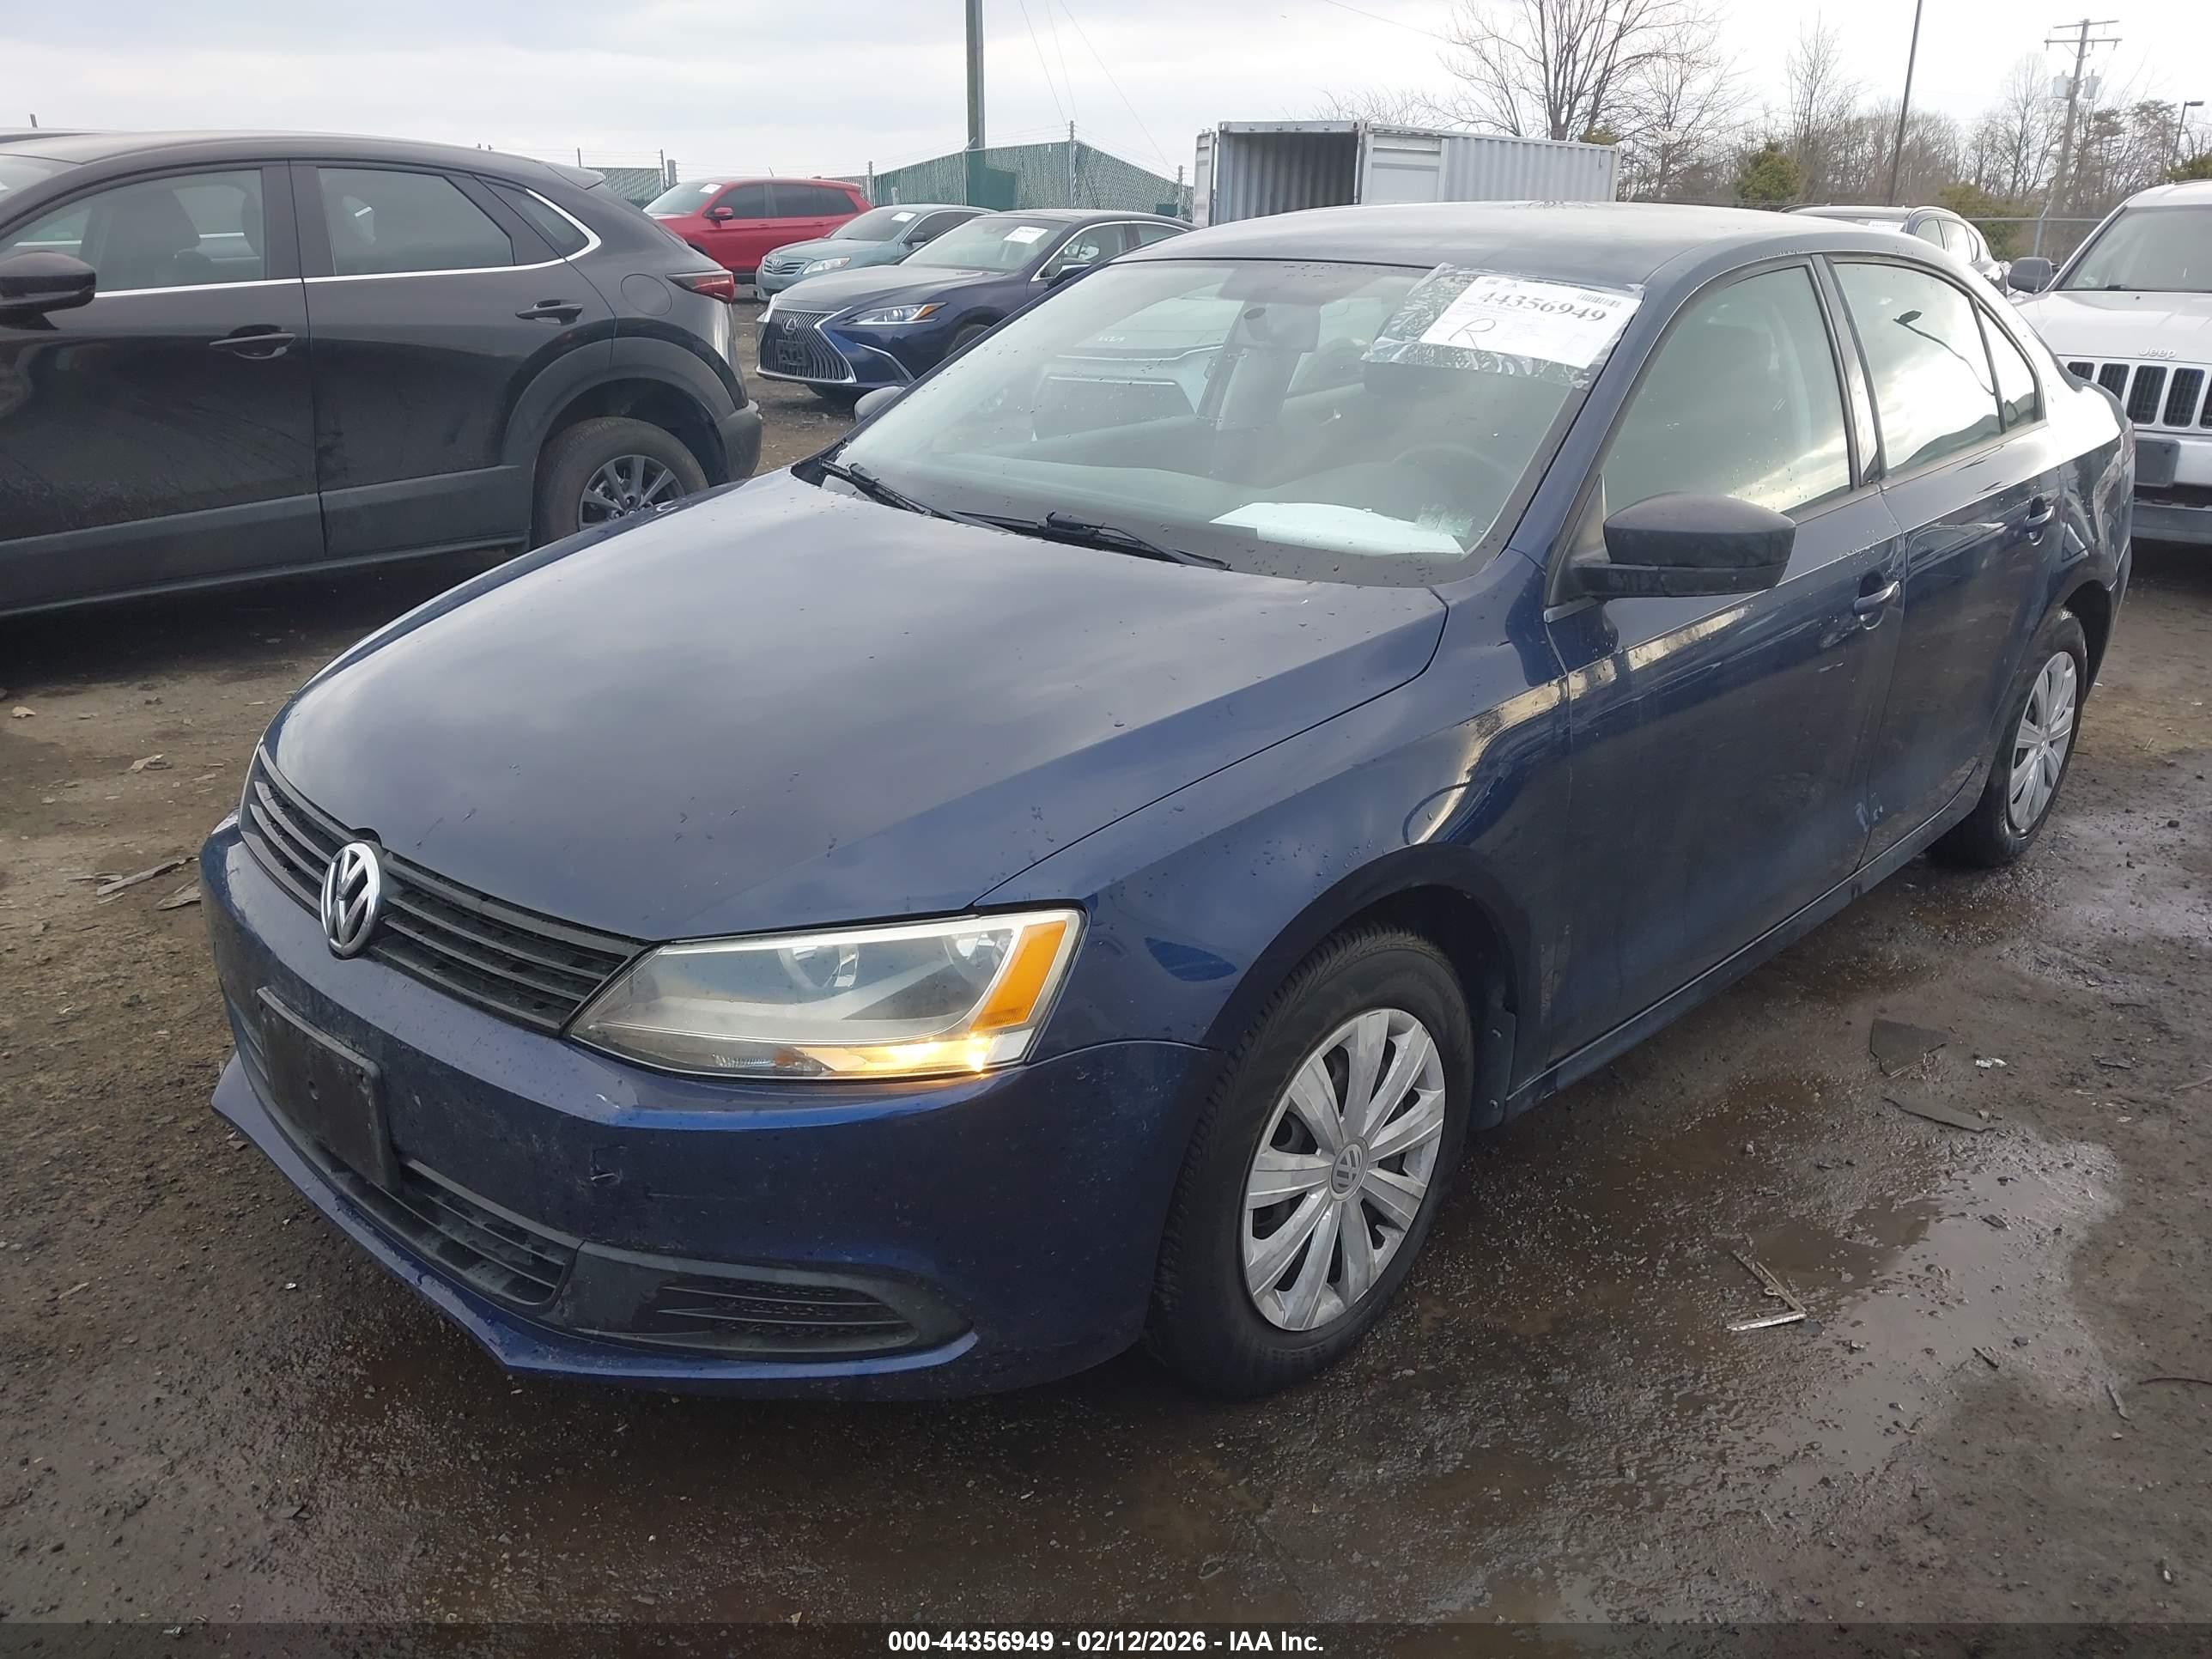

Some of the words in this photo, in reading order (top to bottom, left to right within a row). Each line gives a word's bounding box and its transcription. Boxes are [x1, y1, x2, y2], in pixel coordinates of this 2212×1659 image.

[1478, 291, 1607, 322] 44356949
[1448, 318, 1497, 349] R
[2138, 346, 2177, 359] Jeep
